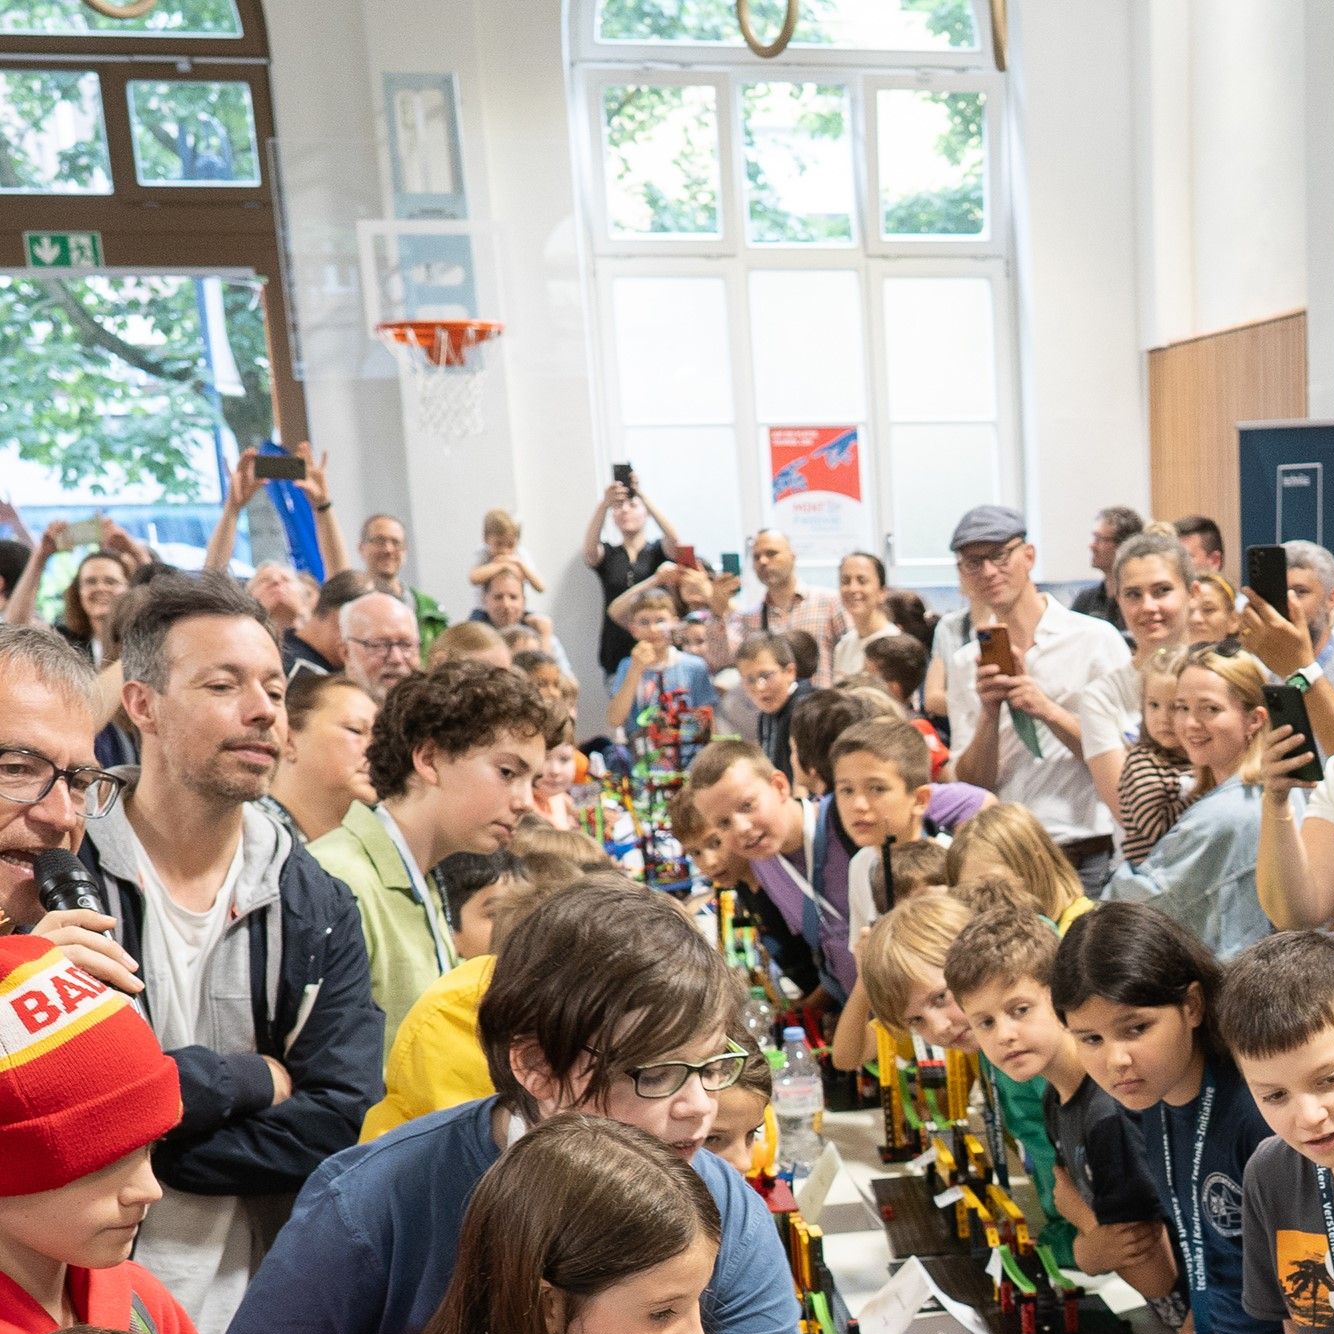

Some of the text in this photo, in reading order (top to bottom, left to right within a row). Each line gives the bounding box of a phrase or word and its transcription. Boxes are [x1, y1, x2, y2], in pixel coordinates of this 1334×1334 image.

[1191, 1085, 1216, 1181] Technik-Initiative
[1171, 1196, 1187, 1239] Zukunft
[1191, 1184, 1201, 1239] Karlsruher
[1193, 1246, 1207, 1291] technika
